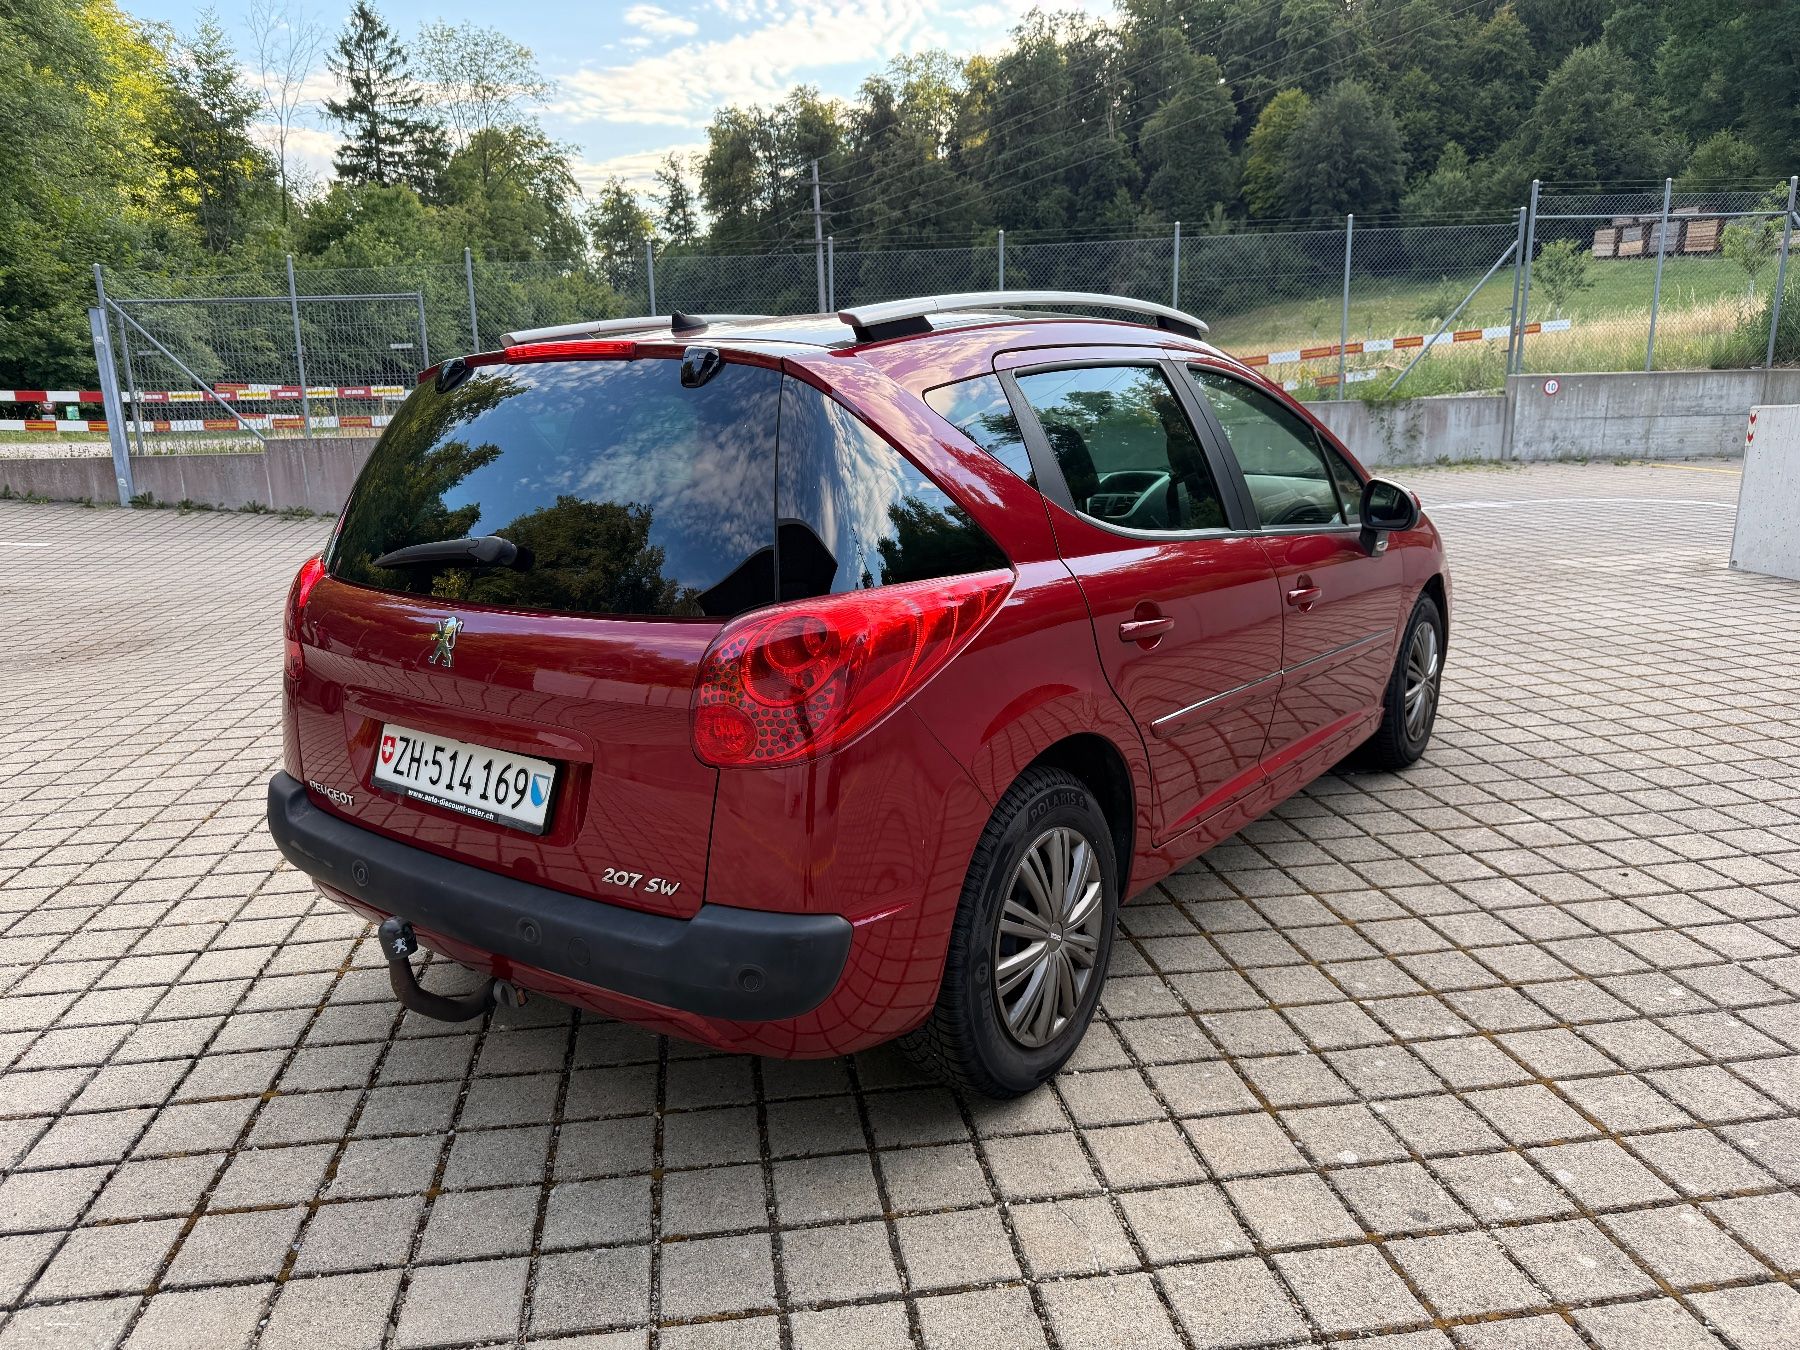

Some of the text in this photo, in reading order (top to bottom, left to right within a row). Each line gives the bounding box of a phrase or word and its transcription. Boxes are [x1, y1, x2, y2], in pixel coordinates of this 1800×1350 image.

[1547, 382, 1557, 391] 10
[309, 780, 354, 806] PEUGEOT
[408, 789, 495, 820] www.auto-discount-uster.ch
[1030, 792, 1076, 822] POLARIS
[601, 867, 681, 896] 207 SW
